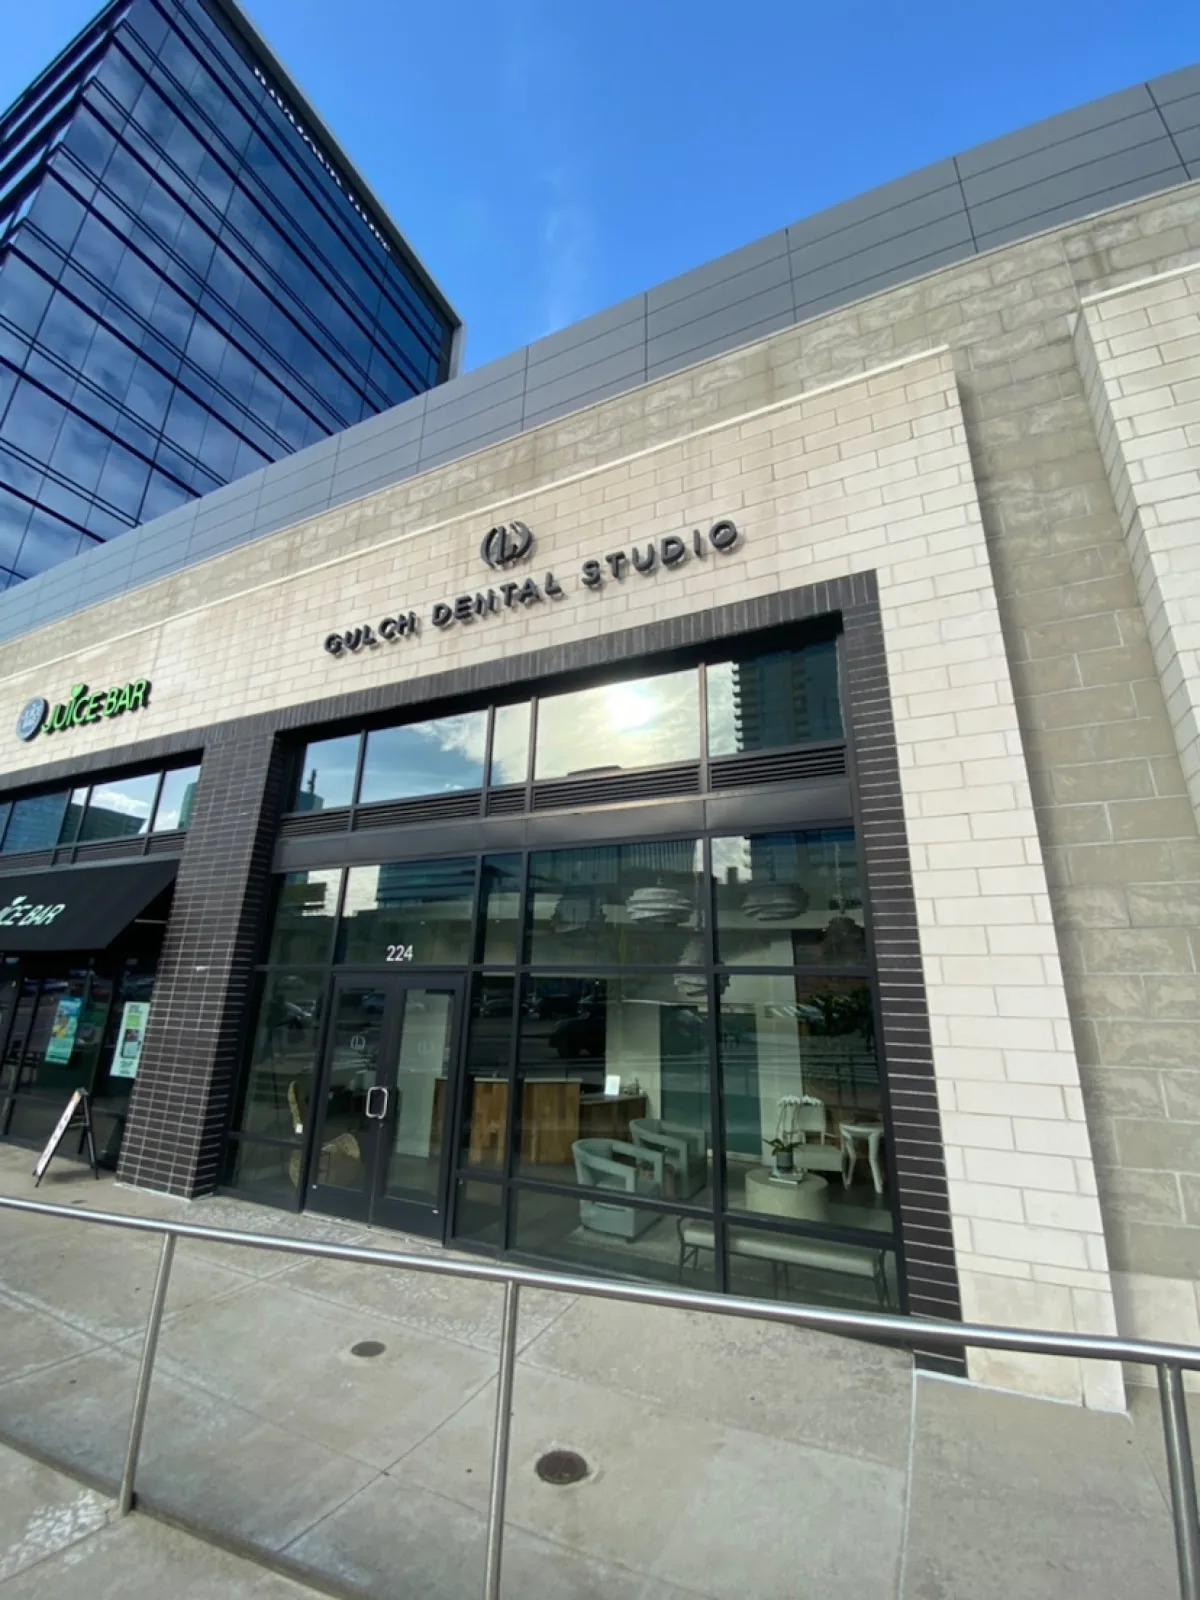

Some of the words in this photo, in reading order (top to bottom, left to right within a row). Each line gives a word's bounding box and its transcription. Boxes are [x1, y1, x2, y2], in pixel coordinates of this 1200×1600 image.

[324, 611, 416, 655] GULCH
[432, 571, 563, 627] DENTAL
[582, 519, 738, 587] STUDIO
[41, 683, 103, 735] JUICE
[103, 679, 148, 717] BAR
[17, 903, 66, 926] BAR
[386, 944, 414, 962] 224
